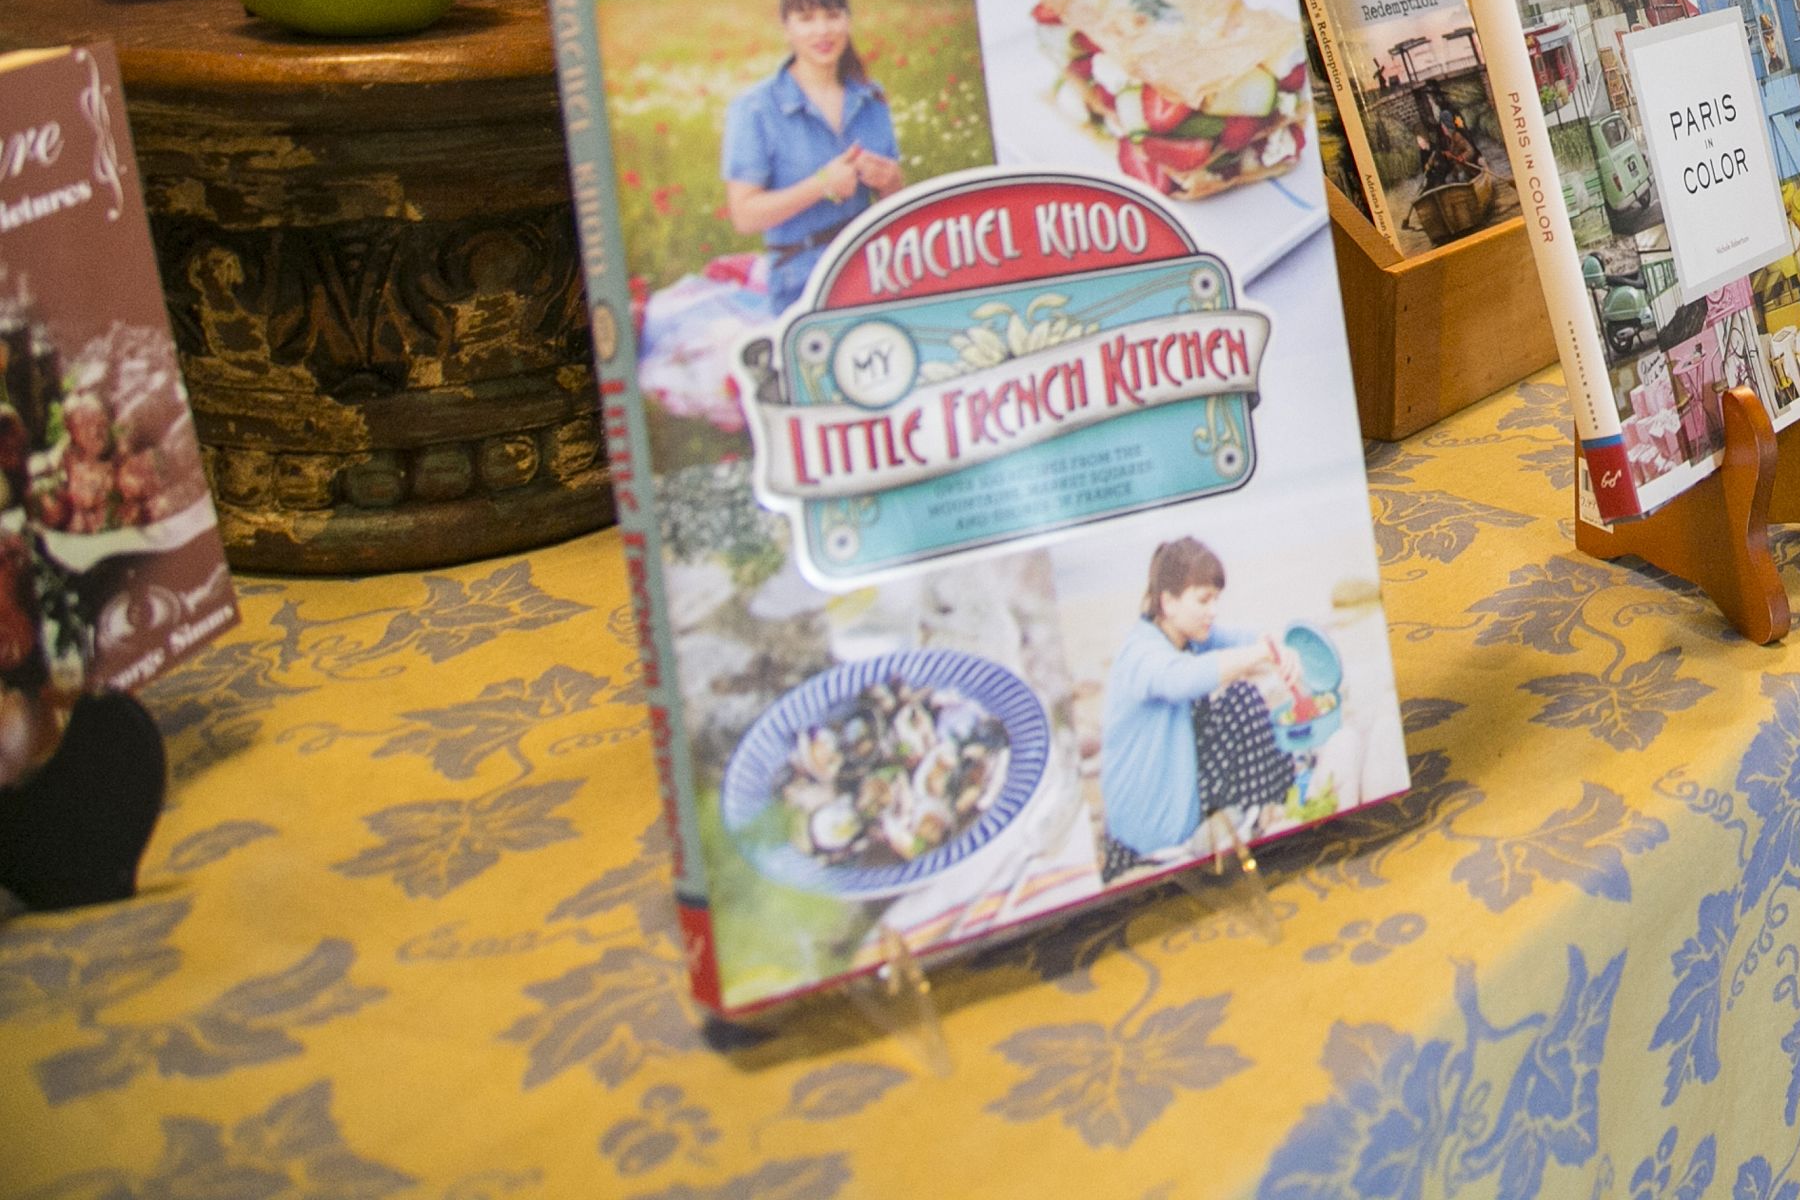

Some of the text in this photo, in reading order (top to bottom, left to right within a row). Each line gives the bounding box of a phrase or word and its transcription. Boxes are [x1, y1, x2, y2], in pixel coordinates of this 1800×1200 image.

[1317, 20, 1344, 92] Redemption
[1670, 94, 1737, 141] PARIS
[1704, 138, 1714, 150] IN
[1507, 91, 1555, 244] PARIS IN COLOR
[1683, 147, 1749, 195] COLOR
[866, 201, 1149, 295] RACHEL KHOO
[852, 345, 894, 382] MY
[787, 410, 929, 488] LITTLE
[940, 353, 1090, 460] FRENCH
[1101, 328, 1252, 408] KITCHEN
